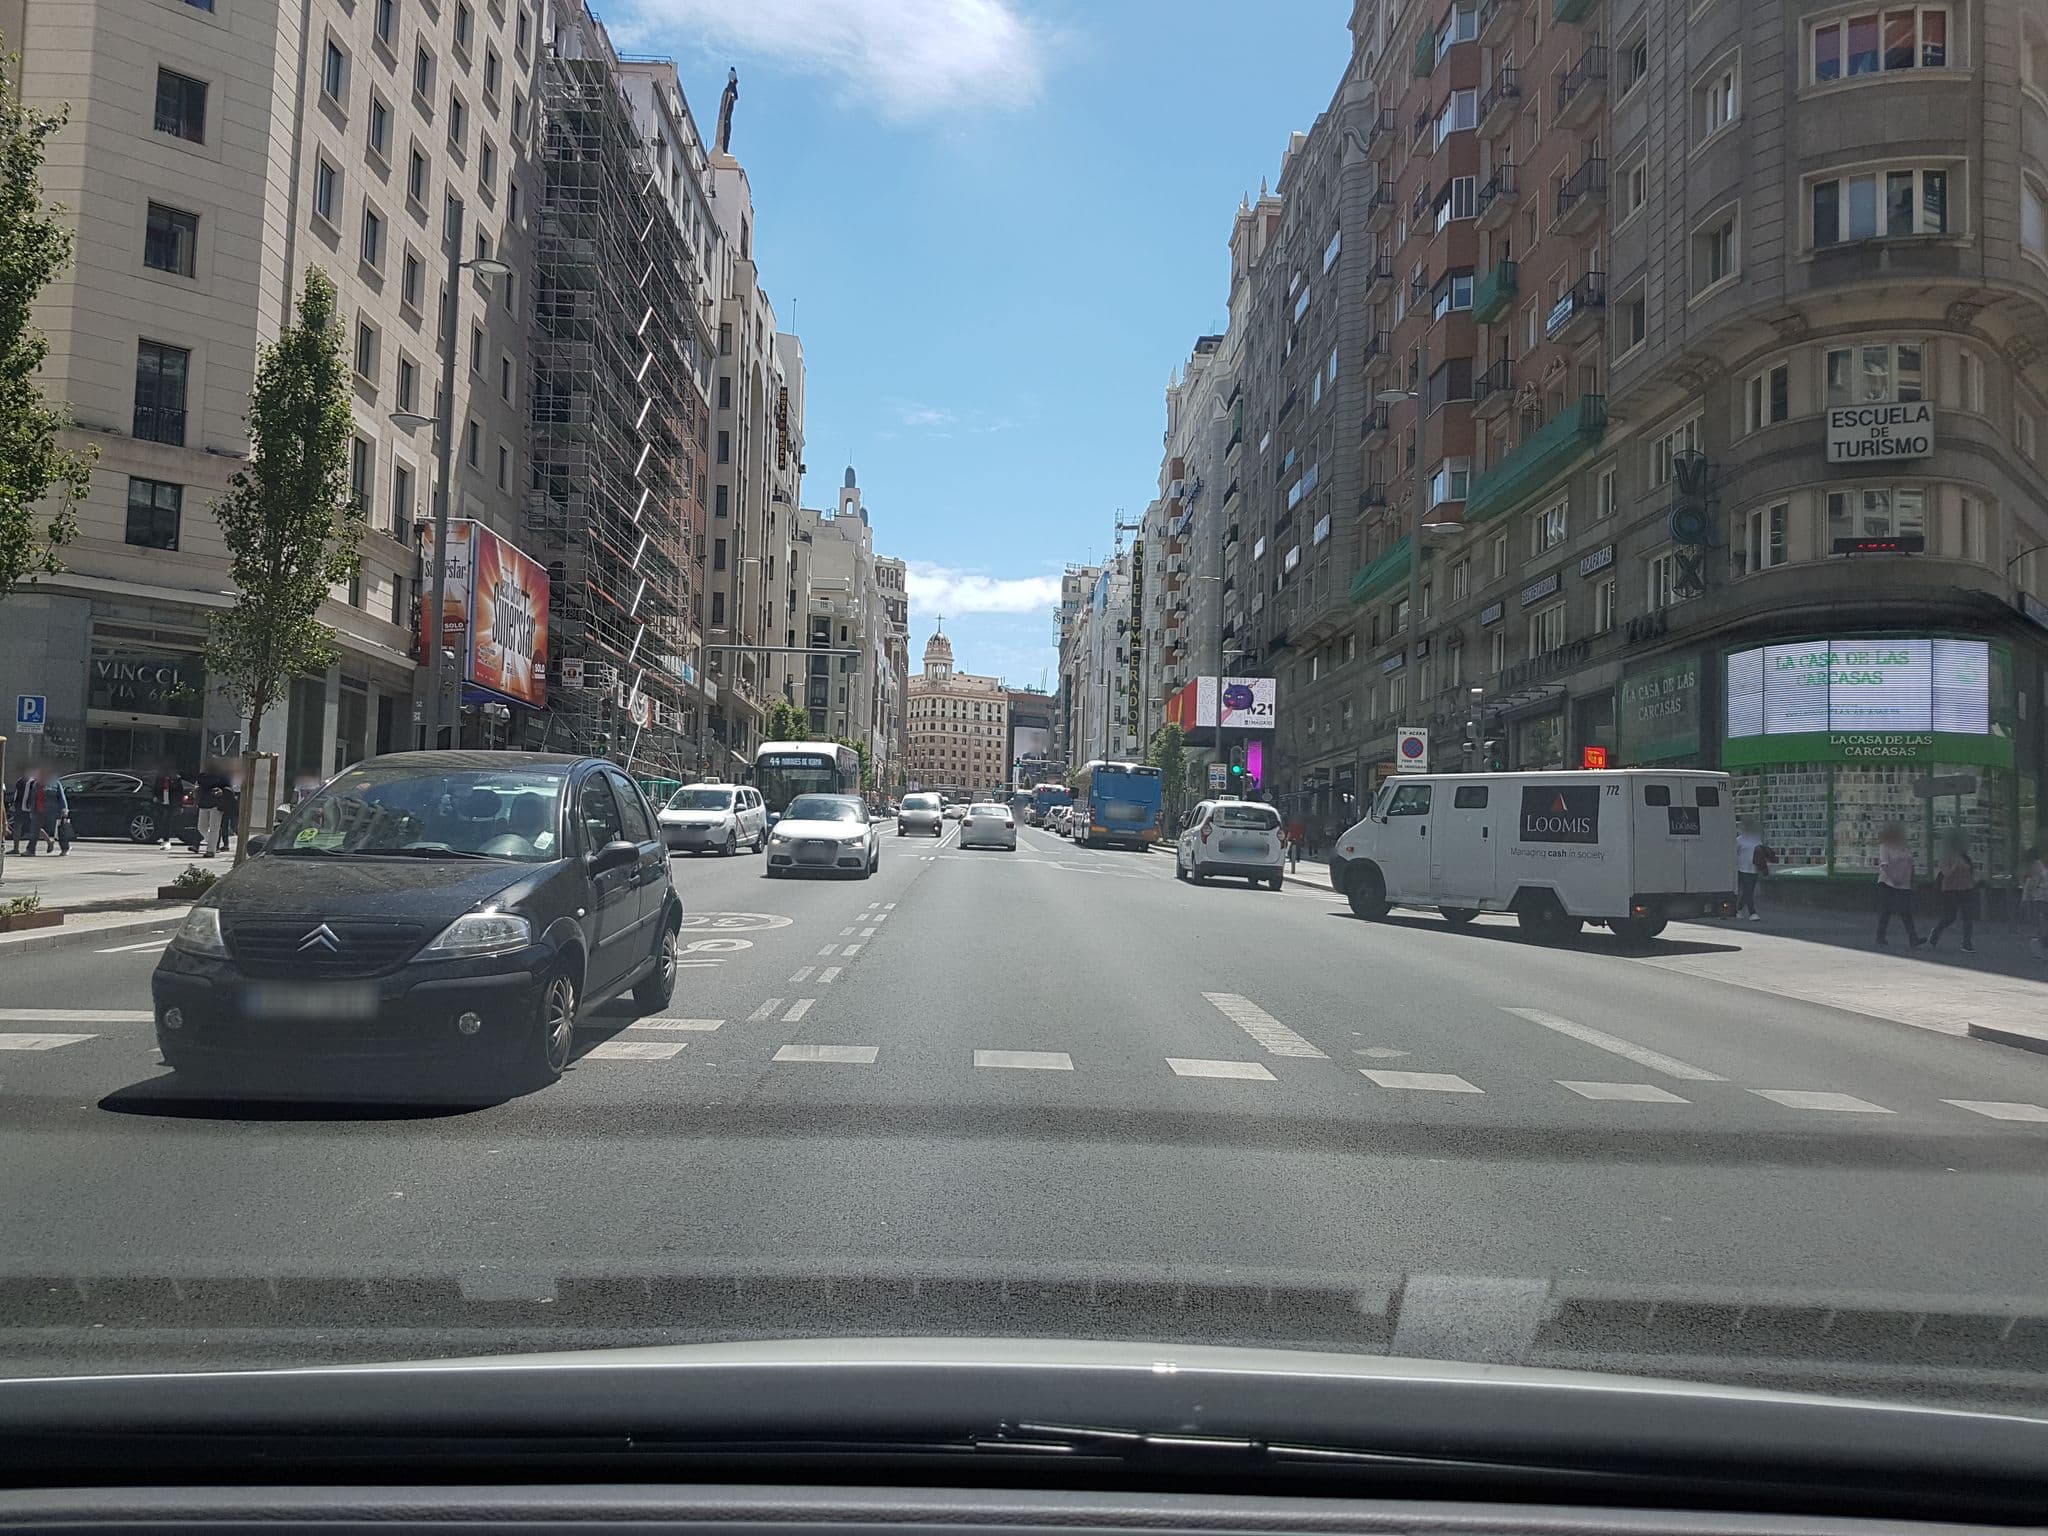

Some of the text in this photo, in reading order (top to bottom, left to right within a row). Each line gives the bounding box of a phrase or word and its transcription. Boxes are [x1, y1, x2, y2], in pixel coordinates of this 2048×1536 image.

[1831, 405, 1930, 428] ESCUELA
[1870, 426, 1889, 438] DE
[1833, 437, 1928, 458] TURISMO
[492, 578, 536, 671] Superstar
[1127, 541, 1143, 736] HOTEL EMPERADOR
[1776, 650, 1910, 670] LA CASA DE LAS
[97, 661, 178, 685] VINCCI
[1798, 671, 1884, 686] CARCASAS
[107, 683, 135, 699] VIA
[1626, 672, 1695, 703] LA CASA DE LAS
[23, 698, 36, 720] P
[1639, 698, 1681, 720] CARCASAS
[1830, 735, 1933, 745] LA CASA DE LAS
[1844, 746, 1917, 757] CARCASAS
[1606, 785, 1620, 796] 772
[1527, 815, 1591, 834] LOOMIS
[1511, 847, 1604, 861] Managing cash in society
